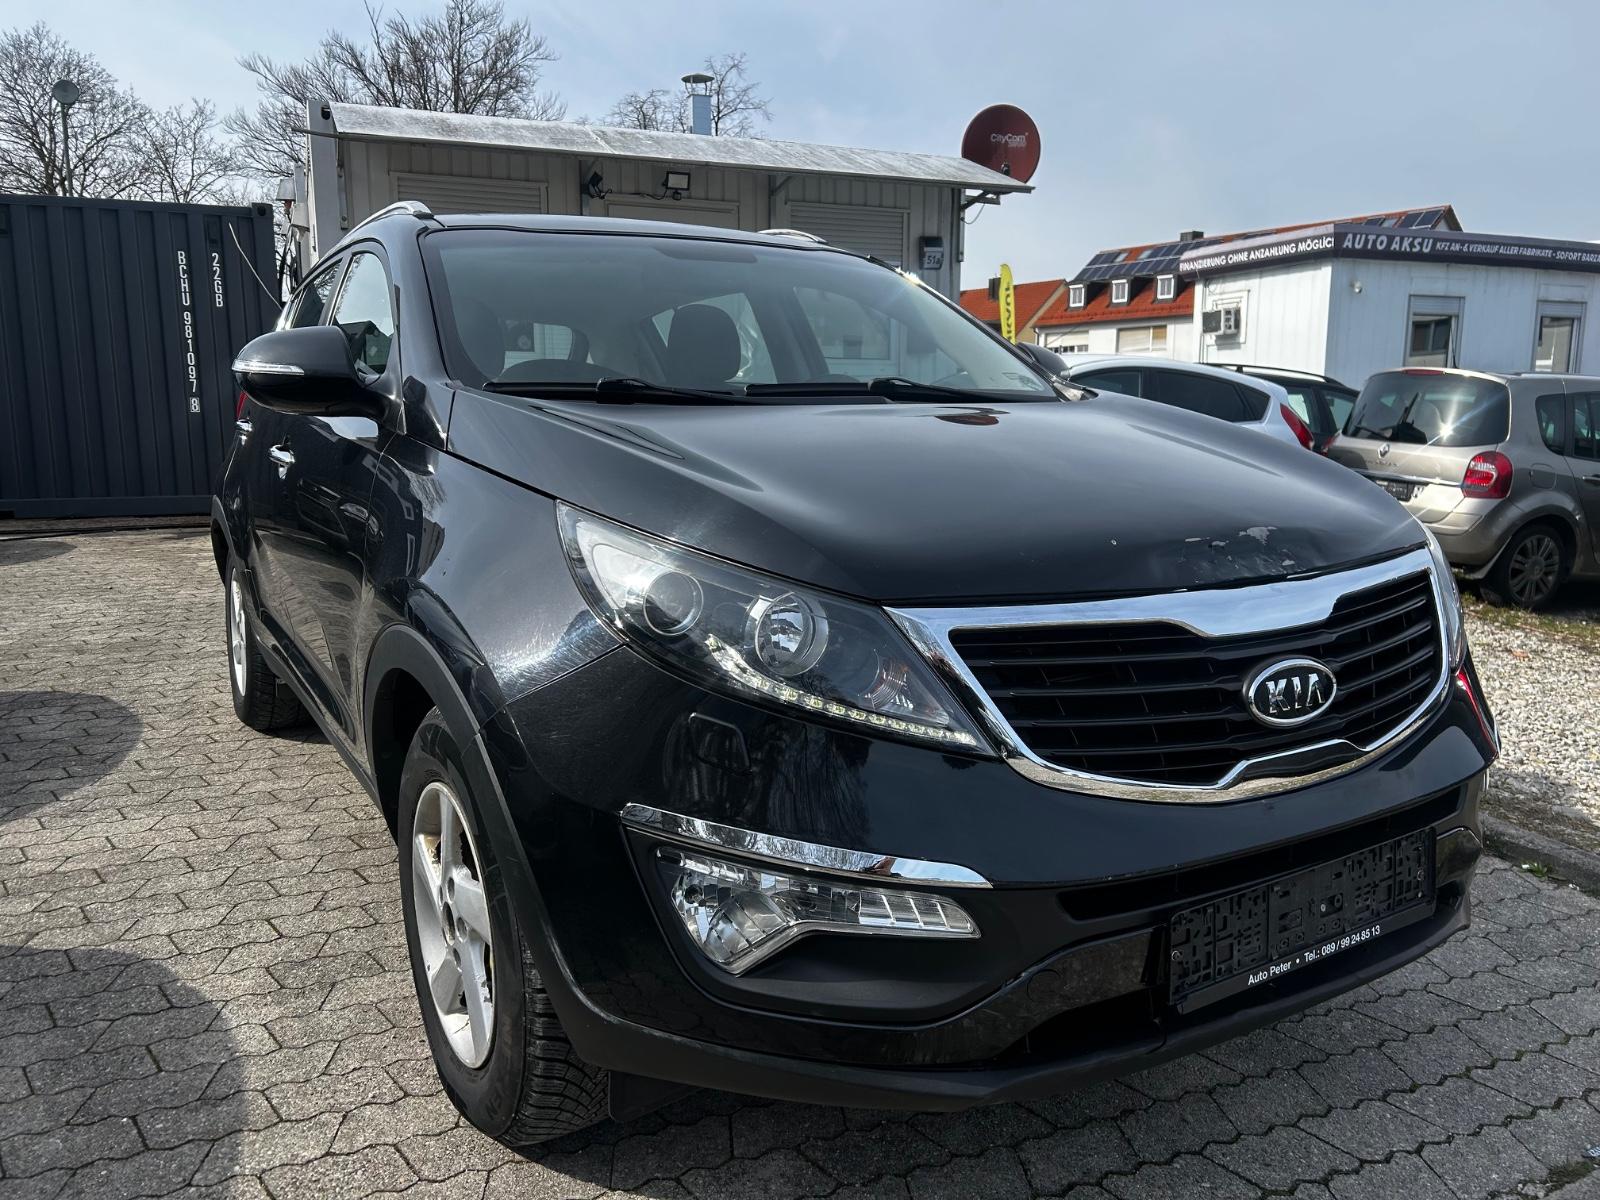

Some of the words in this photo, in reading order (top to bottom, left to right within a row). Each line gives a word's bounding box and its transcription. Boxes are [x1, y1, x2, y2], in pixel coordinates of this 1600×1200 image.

[1228, 251, 1249, 264] OHNE
[1250, 244, 1296, 260] ANZAHLUNG
[1343, 233, 1388, 250] AUTO
[1390, 236, 1434, 253] AKSU
[1435, 241, 1450, 251] KFZ
[1469, 243, 1499, 254] VERKAUF
[1499, 246, 1519, 255] ALLER
[1519, 247, 1553, 258] FABRIKATE
[1555, 251, 1582, 261] SOFORT
[177, 251, 190, 306] BCHU
[184, 311, 197, 393] 981097
[191, 398, 200, 412] 8
[1265, 673, 1325, 713] KIA
[1247, 971, 1268, 985] Auto
[1269, 961, 1292, 977] Peter
[1304, 949, 1320, 963] Tel.:
[1321, 941, 1336, 956] 089
[1340, 936, 1351, 949] 99
[1351, 932, 1361, 946] 24
[1361, 928, 1371, 941] 85
[1371, 924, 1381, 937] 13
